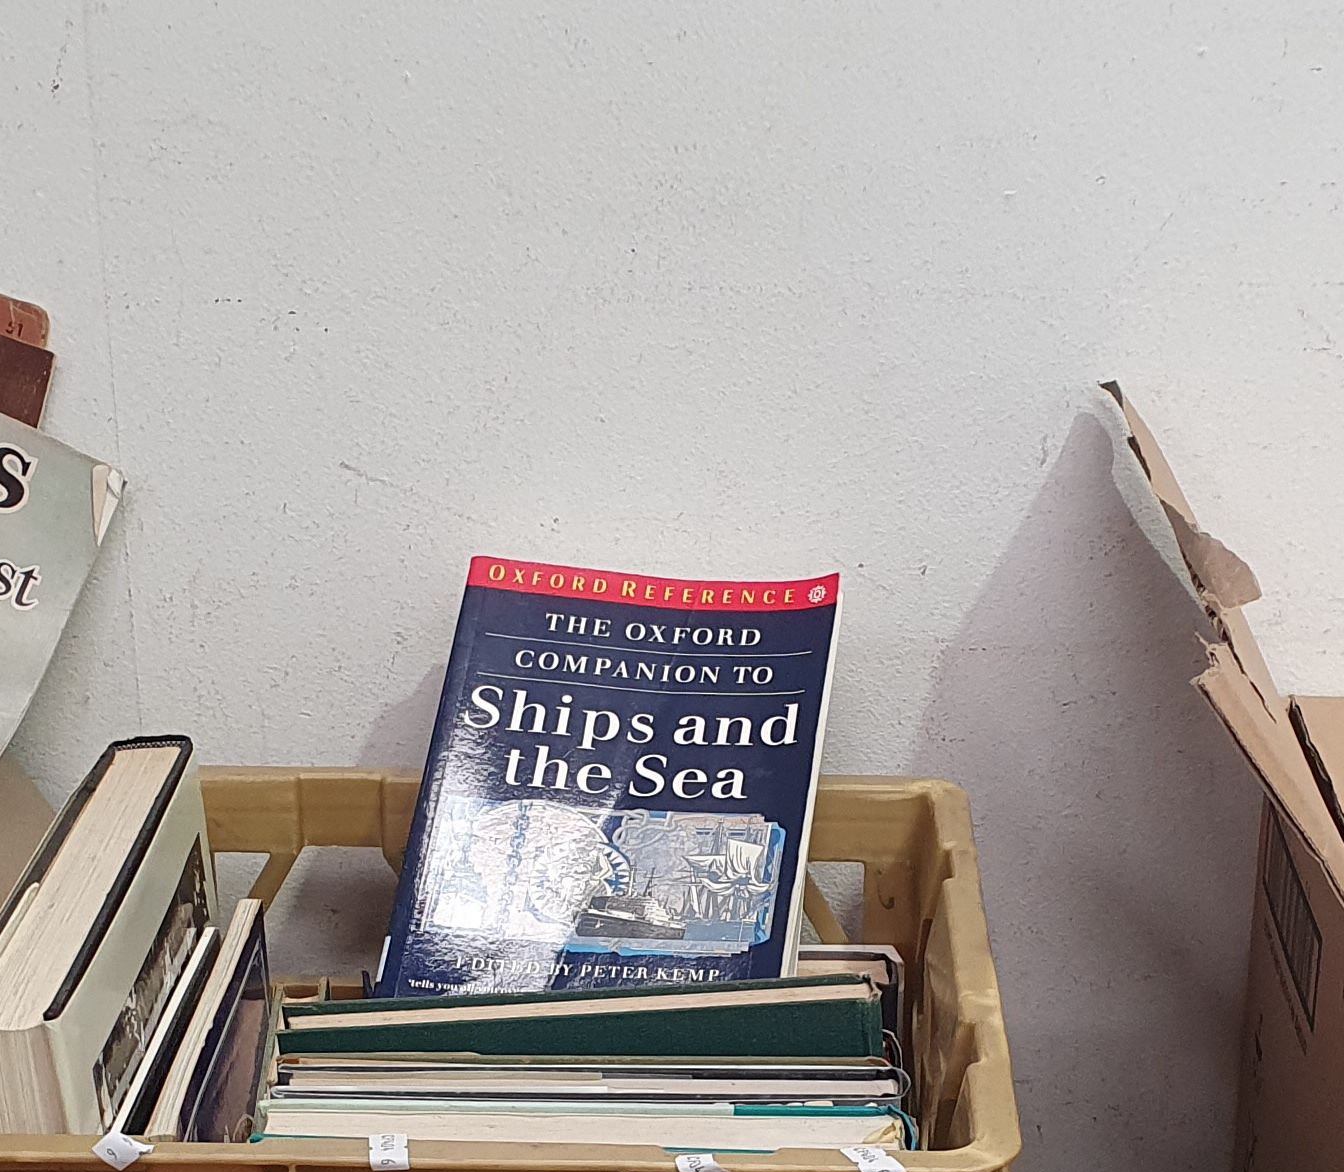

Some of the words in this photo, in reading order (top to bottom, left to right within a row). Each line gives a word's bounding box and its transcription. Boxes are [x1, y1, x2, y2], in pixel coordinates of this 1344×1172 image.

[489, 564, 607, 594] OXFORD
[621, 580, 796, 605] REFERENCE
[546, 612, 611, 639] THE
[625, 622, 762, 647] OXFORD
[515, 649, 721, 685] COMPANION
[733, 665, 774, 686] TO
[463, 685, 656, 750] Ships
[672, 703, 799, 748] and
[504, 745, 613, 794] the
[628, 753, 748, 801] Sea
[579, 965, 650, 982] PETER
[656, 967, 722, 983] KEMP
